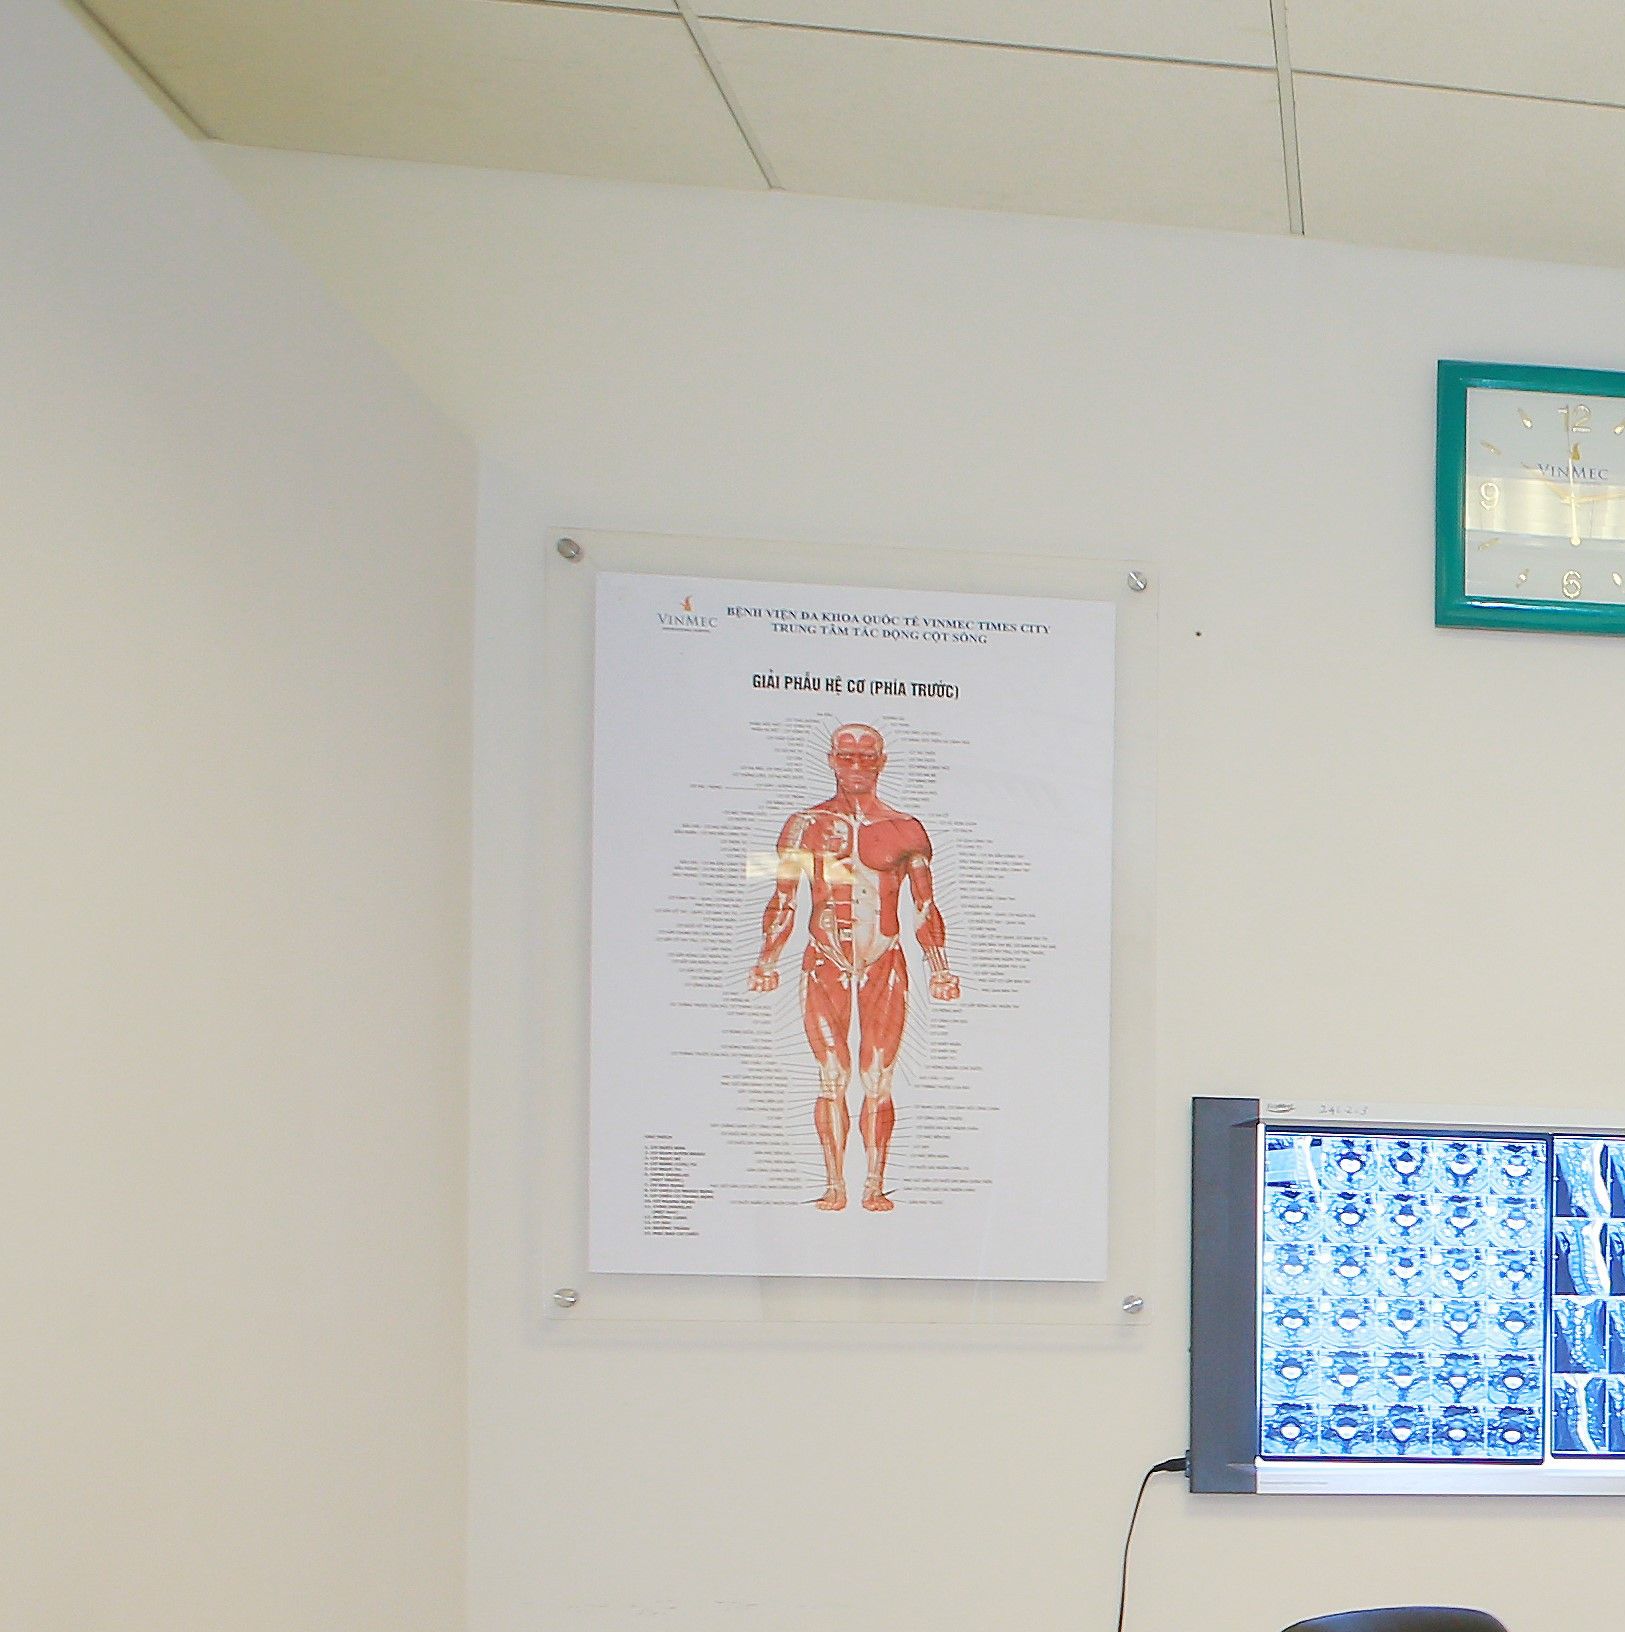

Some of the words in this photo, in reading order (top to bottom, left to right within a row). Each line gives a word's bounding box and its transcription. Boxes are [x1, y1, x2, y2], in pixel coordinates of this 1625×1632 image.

[1562, 570, 1582, 600] 6
[977, 621, 1017, 633] TIMES
[1020, 624, 1050, 635] CITY
